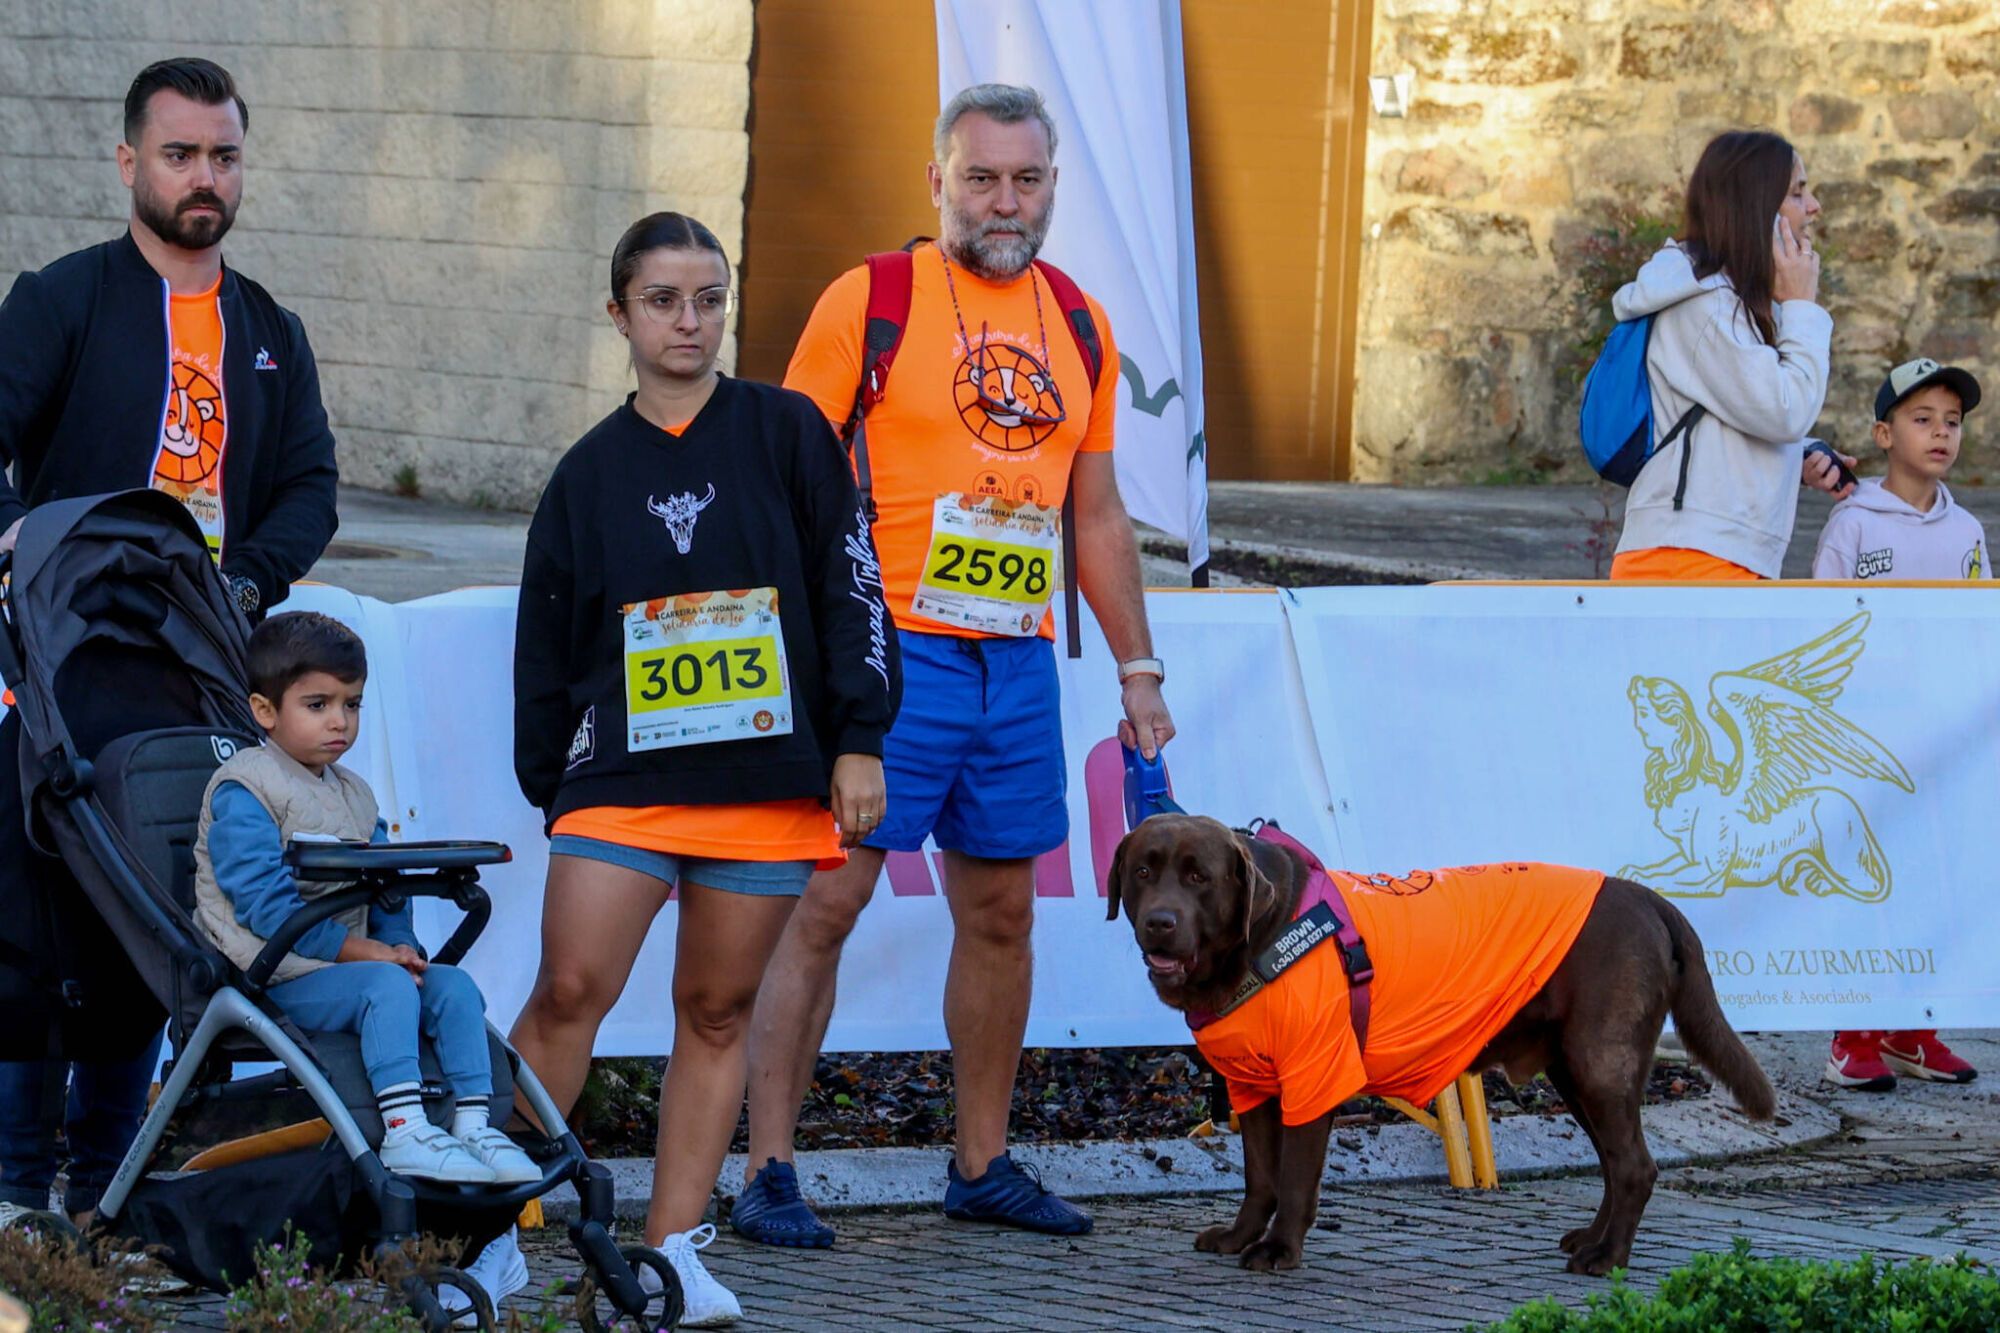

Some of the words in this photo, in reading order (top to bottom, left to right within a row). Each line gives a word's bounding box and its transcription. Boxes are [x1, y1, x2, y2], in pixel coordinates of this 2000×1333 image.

[978, 486, 1003, 494] AEEA
[975, 506, 1010, 518] CARREIRA
[933, 543, 1047, 595] 2598
[1856, 558, 1892, 578] GUYS
[660, 608, 697, 620] CARREIRA
[706, 603, 745, 613] ANDAINA
[640, 647, 768, 701] 3013
[1275, 918, 1316, 954] BROWN
[1765, 947, 1937, 976] AZURMENDI
[1782, 991, 1794, 1004] &
[1799, 989, 1872, 1005] Asociados
